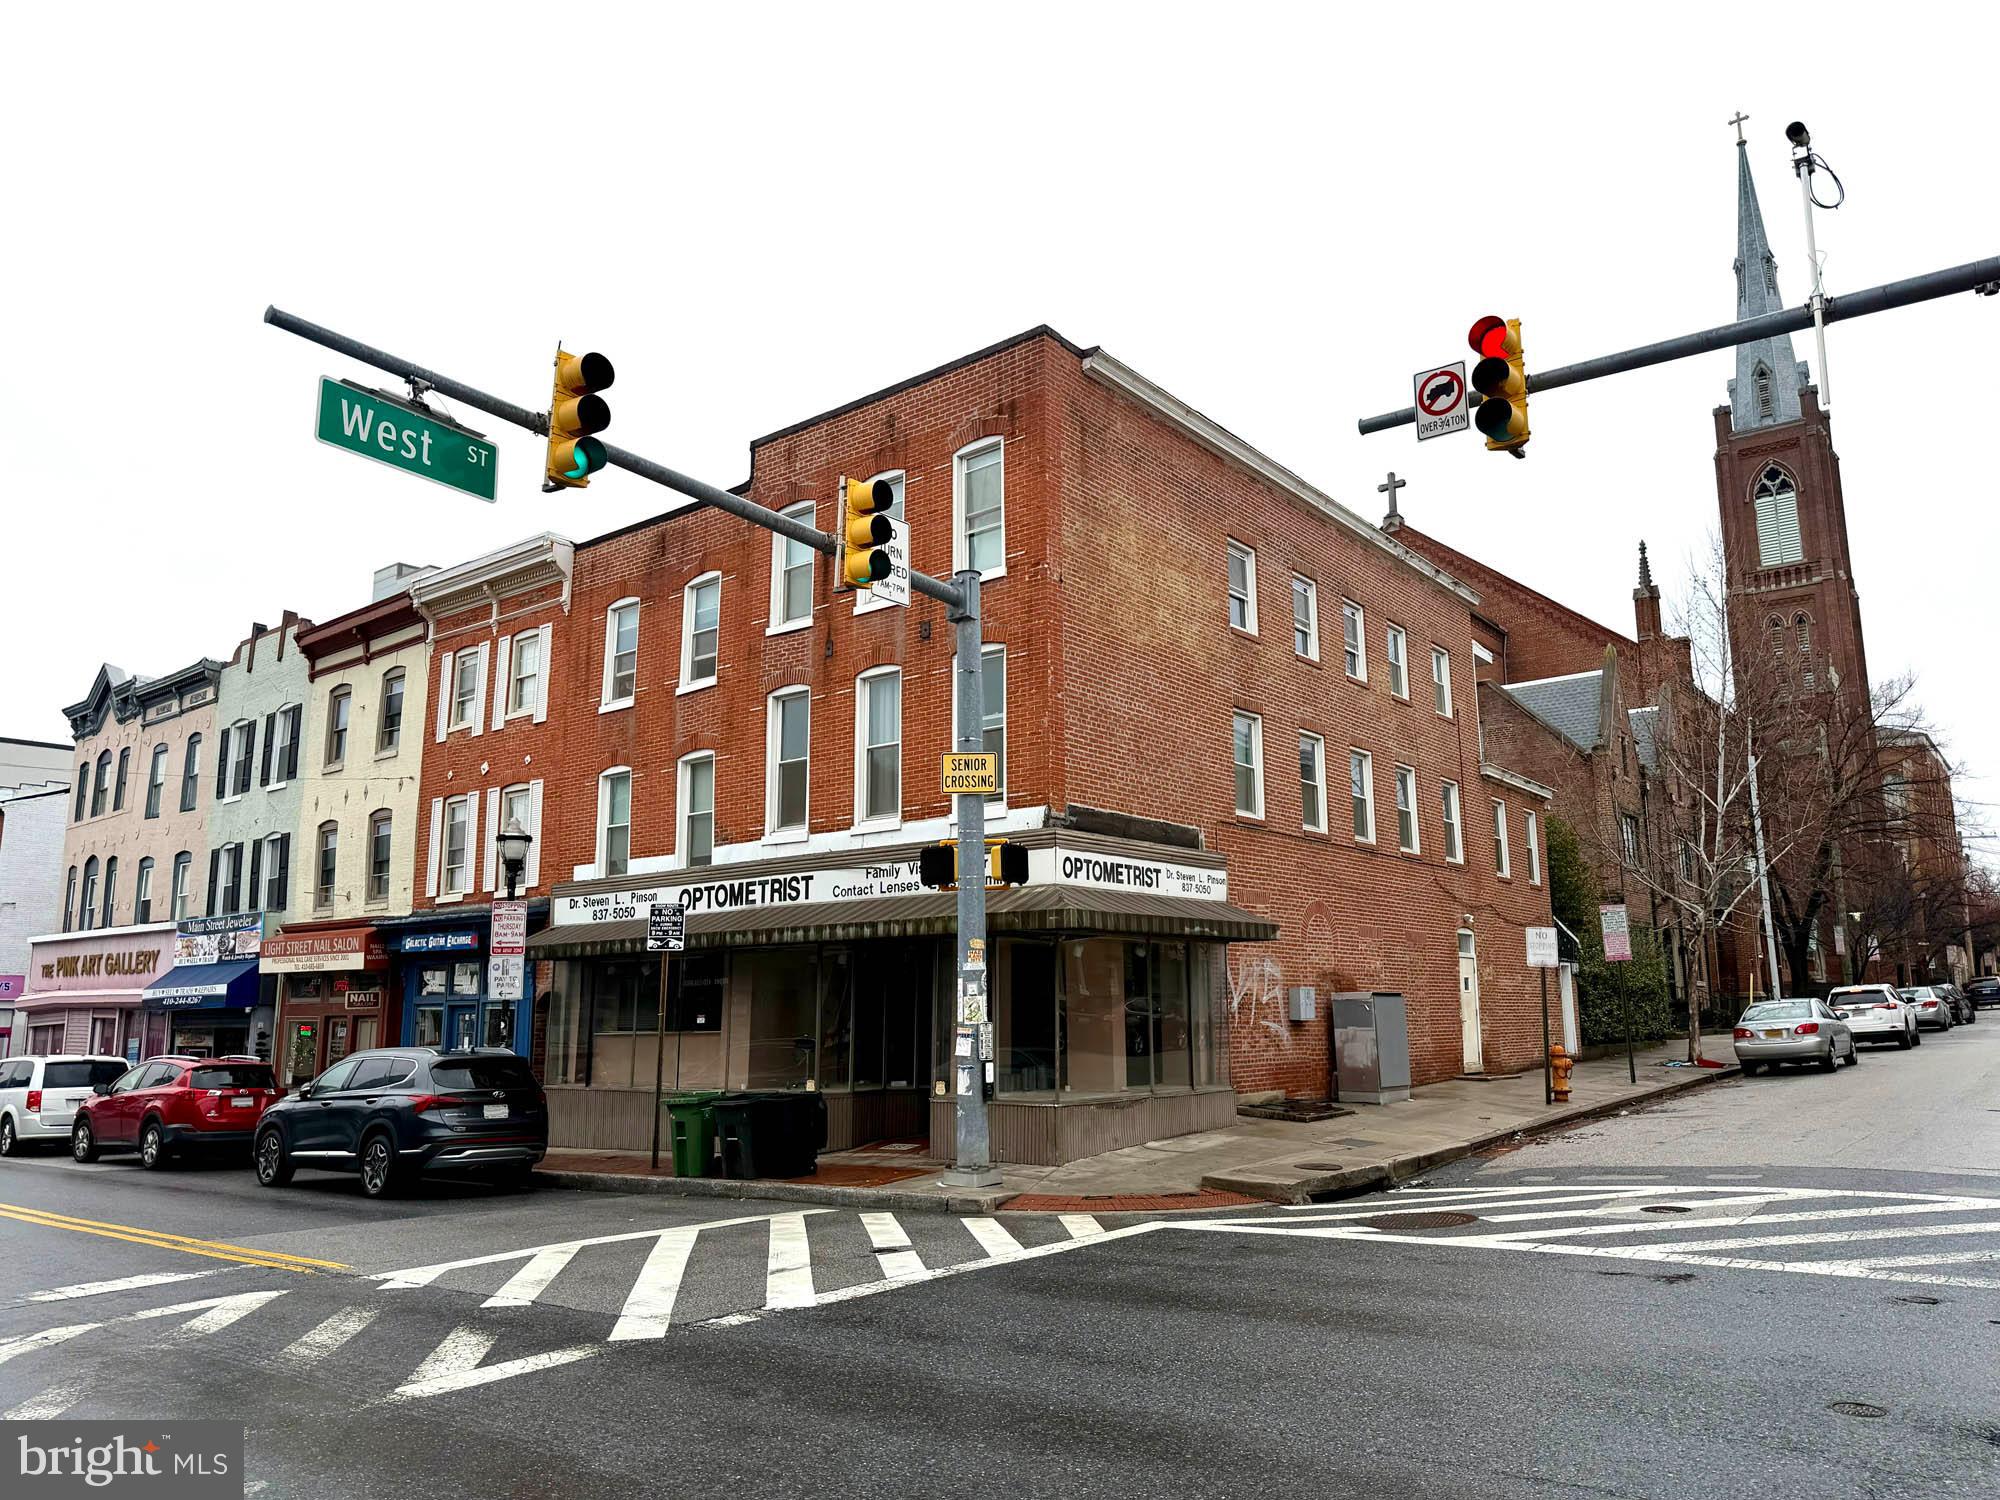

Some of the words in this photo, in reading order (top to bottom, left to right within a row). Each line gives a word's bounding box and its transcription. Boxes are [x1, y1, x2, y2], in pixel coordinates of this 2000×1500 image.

[341, 399, 432, 466] West
[467, 446, 489, 466] ST
[1420, 421, 1438, 434] OVER
[1438, 415, 1450, 430] 3/4
[1451, 414, 1466, 426] TON
[951, 758, 987, 771] SENIOR
[944, 774, 994, 788] CROSSING
[865, 863, 901, 880] Family
[1062, 855, 1162, 889] OPTOMETRIST
[1166, 870, 1175, 880] Dr.
[1176, 871, 1196, 883] Steven
[1199, 873, 1205, 884] L.
[1207, 875, 1226, 886] Pinson
[678, 875, 814, 912] OPTOMETRIST
[832, 883, 874, 898] Contact
[879, 880, 920, 895] Lenses
[569, 898, 581, 910] Dr.
[583, 895, 610, 908] Steven
[615, 894, 625, 905] L.
[630, 890, 658, 905] Pinson
[592, 906, 636, 921] 837-5050
[661, 908, 674, 916] NO
[187, 921, 205, 933] Main
[205, 919, 225, 931] Street
[225, 915, 253, 929] Jeweler
[1535, 931, 1548, 940] NO
[264, 941, 285, 956] LIGHT
[286, 939, 312, 955] STREET
[313, 938, 332, 952] NAIL
[333, 936, 360, 952] SALON
[41, 964, 55, 979] THE
[56, 955, 81, 978] PINK
[80, 952, 104, 977] ART
[104, 949, 161, 977] GALLERY
[350, 993, 377, 1003] NAIL
